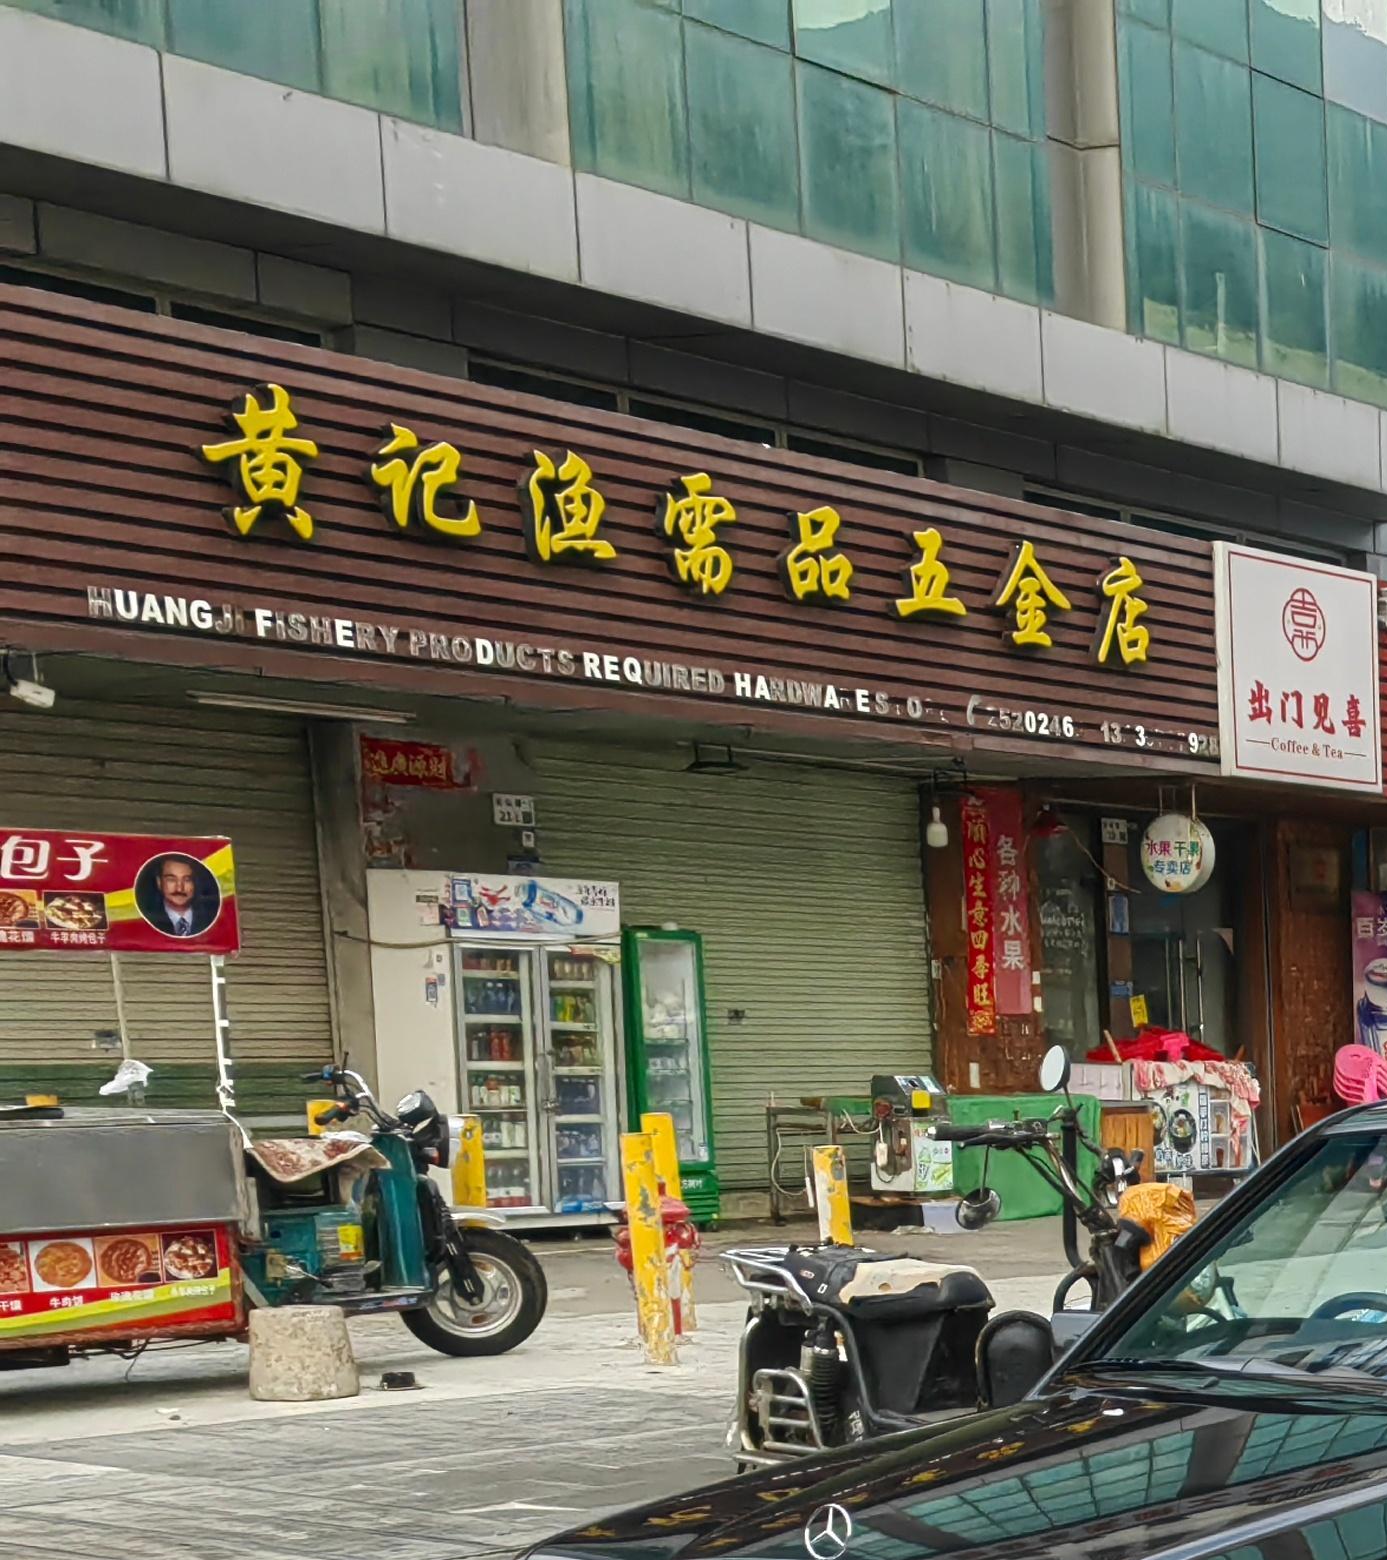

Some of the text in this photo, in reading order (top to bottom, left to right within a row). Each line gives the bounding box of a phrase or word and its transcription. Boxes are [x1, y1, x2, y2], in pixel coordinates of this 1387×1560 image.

[200, 383, 1149, 664] 黄记渔需品五金店
[410, 630, 575, 675] PRODUCTS
[583, 652, 725, 694] REQUIRED
[1248, 680, 1367, 738] 出门见喜
[1271, 737, 1343, 760] Coffee & Tea
[1, 835, 108, 881] 包子
[1154, 861, 1191, 875] 专卖店
[998, 835, 1025, 970] 各种水果
